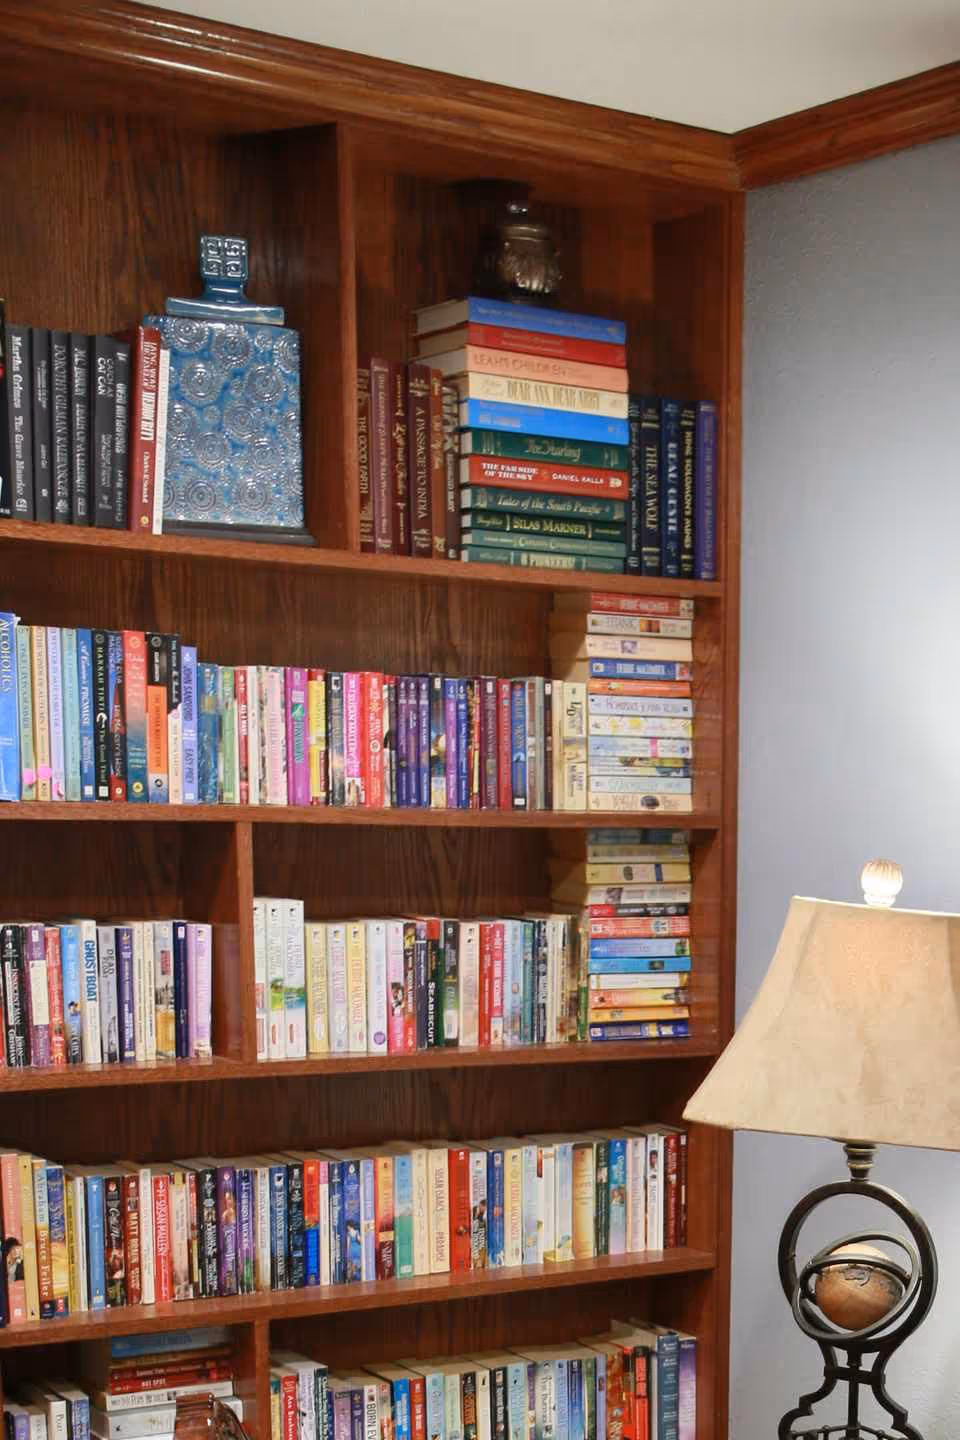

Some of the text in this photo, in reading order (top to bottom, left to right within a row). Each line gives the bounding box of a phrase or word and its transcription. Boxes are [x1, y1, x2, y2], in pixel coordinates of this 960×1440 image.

[11, 336, 23, 408] Martha Grimes
[54, 344, 67, 433] DOROTHY GILMAN
[97, 357, 106, 395] CAT CAN
[106, 358, 114, 383] CATCH
[14, 416, 25, 496] The Grave Maurice
[358, 416, 368, 494] THE GOOD EARTH
[416, 407, 427, 520] A PASSAGE TO INDIA
[481, 462, 539, 474] THE FAR SIDE
[485, 470, 534, 481] OF THE SKY
[552, 473, 604, 485] DANIEL KALLA
[646, 446, 658, 531] THE SEA WOLF
[497, 495, 522, 506] Tales
[513, 515, 587, 536] SILAS MARNER
[97, 647, 105, 684] HANNAH
[114, 635, 122, 663] SUSAN
[184, 666, 192, 722] JOHN SANDFORD
[100, 765, 108, 783] Thief
[185, 748, 194, 784] EASY PREY
[85, 940, 97, 1002] GHOSTBOAT
[12, 968, 22, 1024] INNOCENT MAN
[428, 982, 436, 1044] SEABISCUIT
[8, 1029, 24, 1065] JOHN GRISHAM
[38, 1174, 52, 1296] Abraham Bruce Feiler
[367, 1403, 376, 1428] BORN
